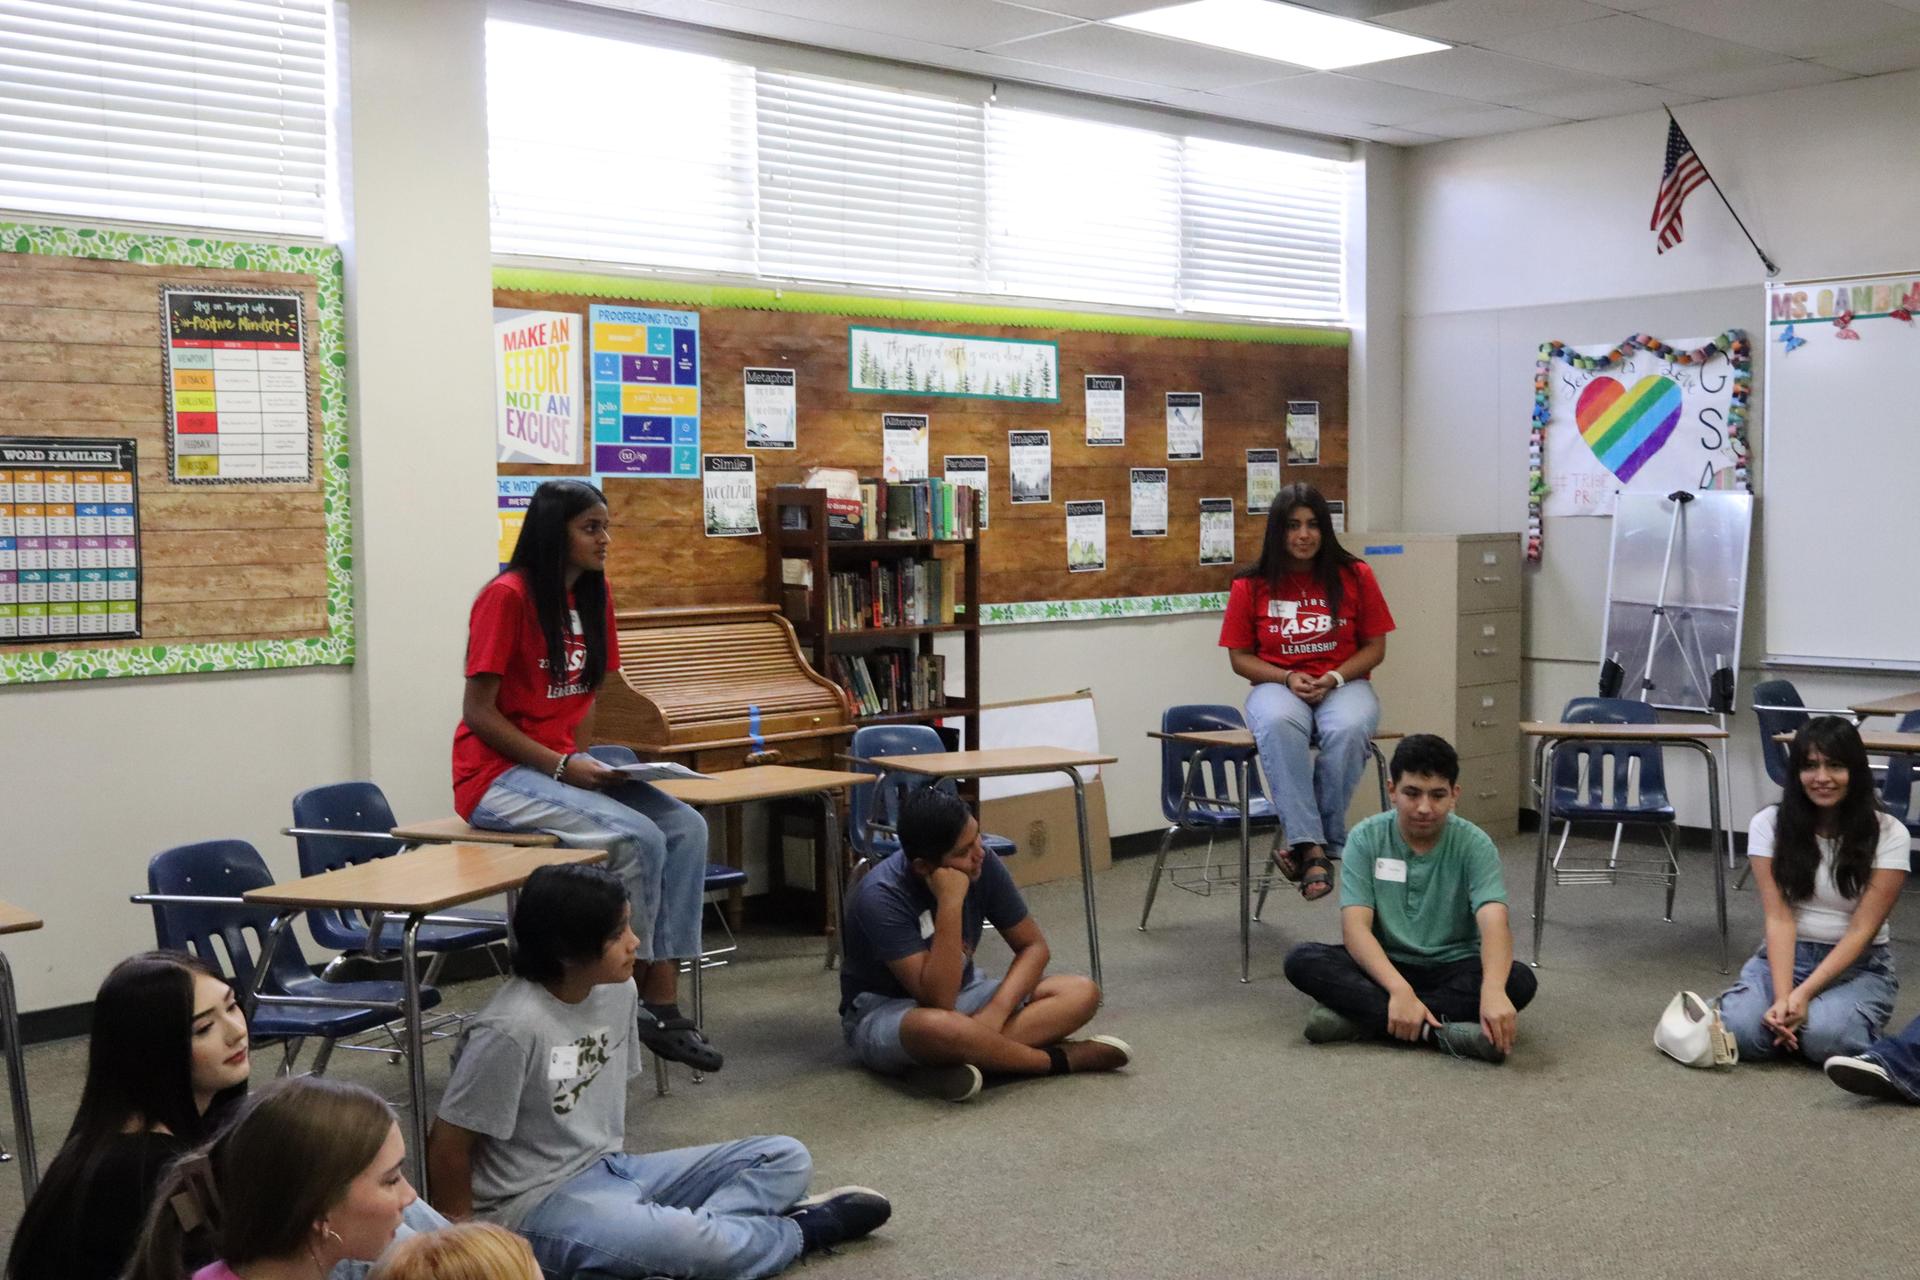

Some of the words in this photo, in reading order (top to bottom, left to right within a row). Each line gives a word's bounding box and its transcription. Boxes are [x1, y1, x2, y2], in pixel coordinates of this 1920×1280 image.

[194, 300, 210, 314] Stay
[225, 302, 249, 315] Target
[1771, 290, 1814, 320] MS.
[192, 315, 236, 333] Positive
[238, 315, 281, 335] Mindset
[599, 309, 661, 325] PROOFREADING
[663, 314, 689, 327] TOOLS
[504, 323, 547, 351] MAKE
[551, 317, 569, 344] AN
[504, 344, 570, 394] EFFORT
[746, 371, 793, 385] Metaphor
[1092, 378, 1116, 390] Irony
[506, 391, 542, 411] NOT
[547, 395, 570, 417] AN
[506, 408, 570, 457] EXCUSE
[1010, 433, 1048, 446] Imagery
[3, 450, 45, 461] WORD
[48, 450, 113, 461] FAMILIES
[711, 458, 747, 470] Simile
[1296, 599, 1327, 608] RIBE
[1282, 615, 1333, 636] ASB
[1281, 641, 1338, 655] LEADERSHIP
